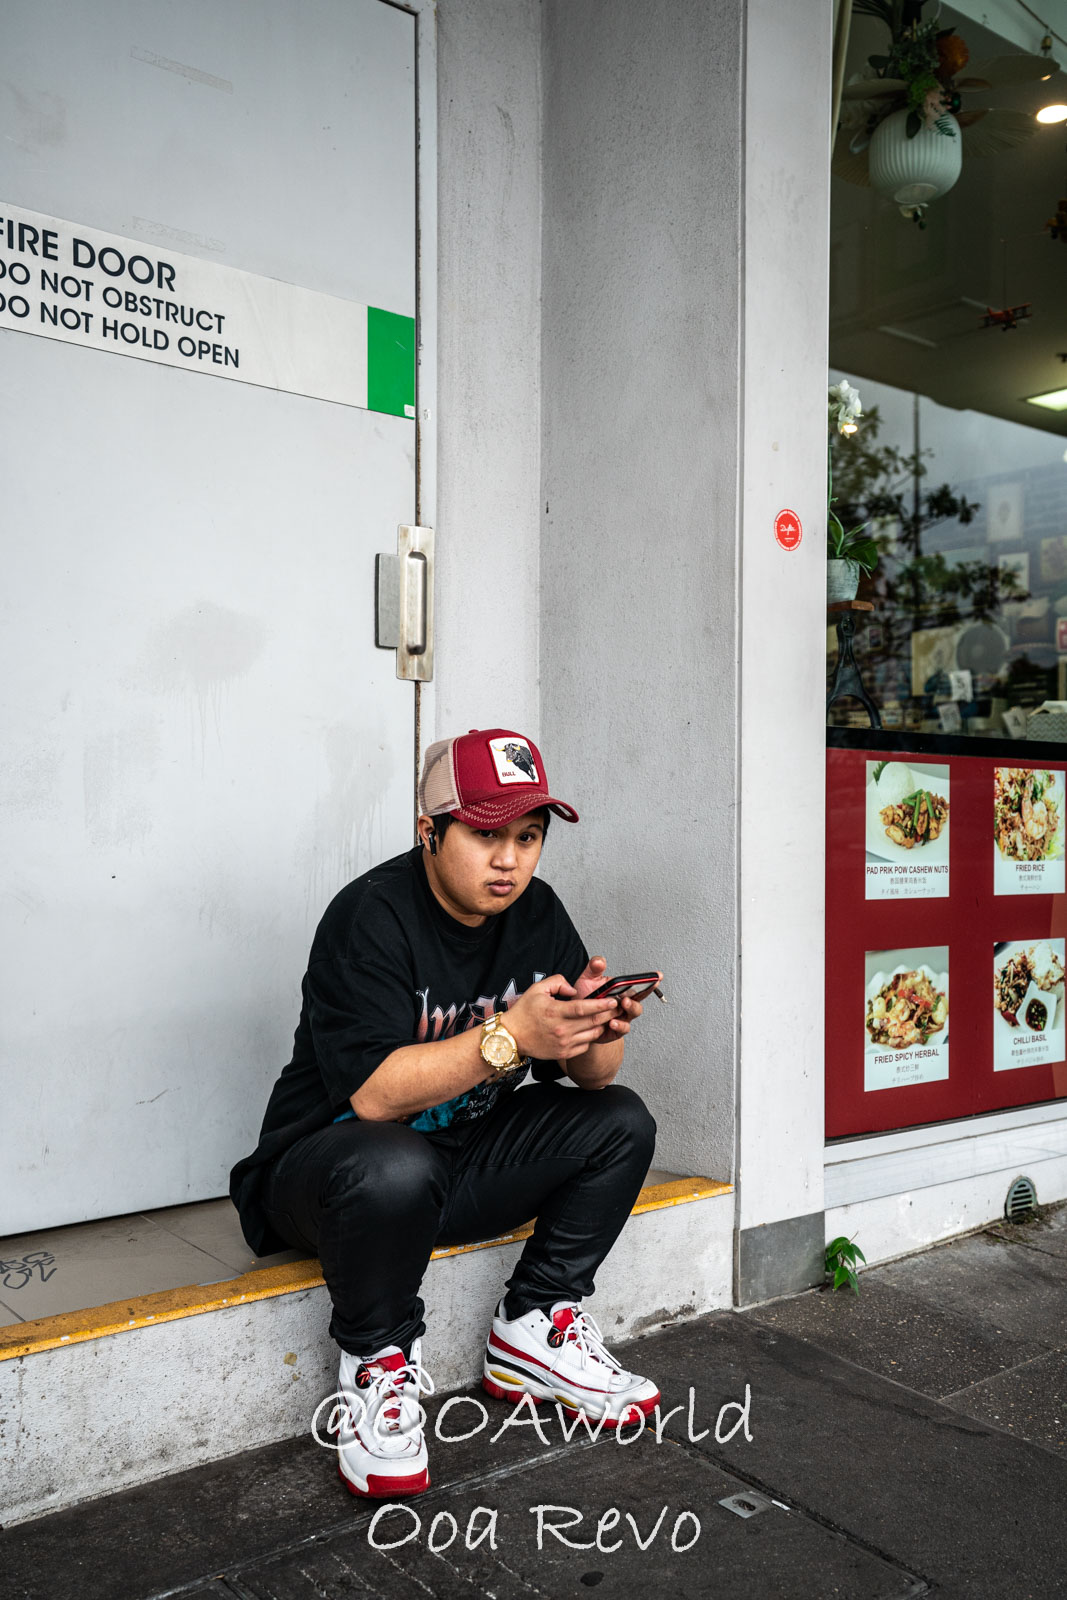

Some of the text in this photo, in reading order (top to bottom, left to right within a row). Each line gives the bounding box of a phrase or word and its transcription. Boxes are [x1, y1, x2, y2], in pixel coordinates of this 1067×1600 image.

[0, 217, 176, 292] IRE DOOR
[41, 269, 94, 301] NOT
[102, 286, 226, 334] OBSTRUCT
[40, 301, 94, 334] NOT
[102, 316, 170, 350] HOLD
[177, 336, 240, 368] OPEN
[866, 865, 949, 875] PAD PRIK POW CASHEW NUTS
[1015, 864, 1045, 872] FRIED RICE
[1013, 1034, 1047, 1045] CHILLI BASIL
[874, 1048, 940, 1064] FRIED SPICY HERBAL
